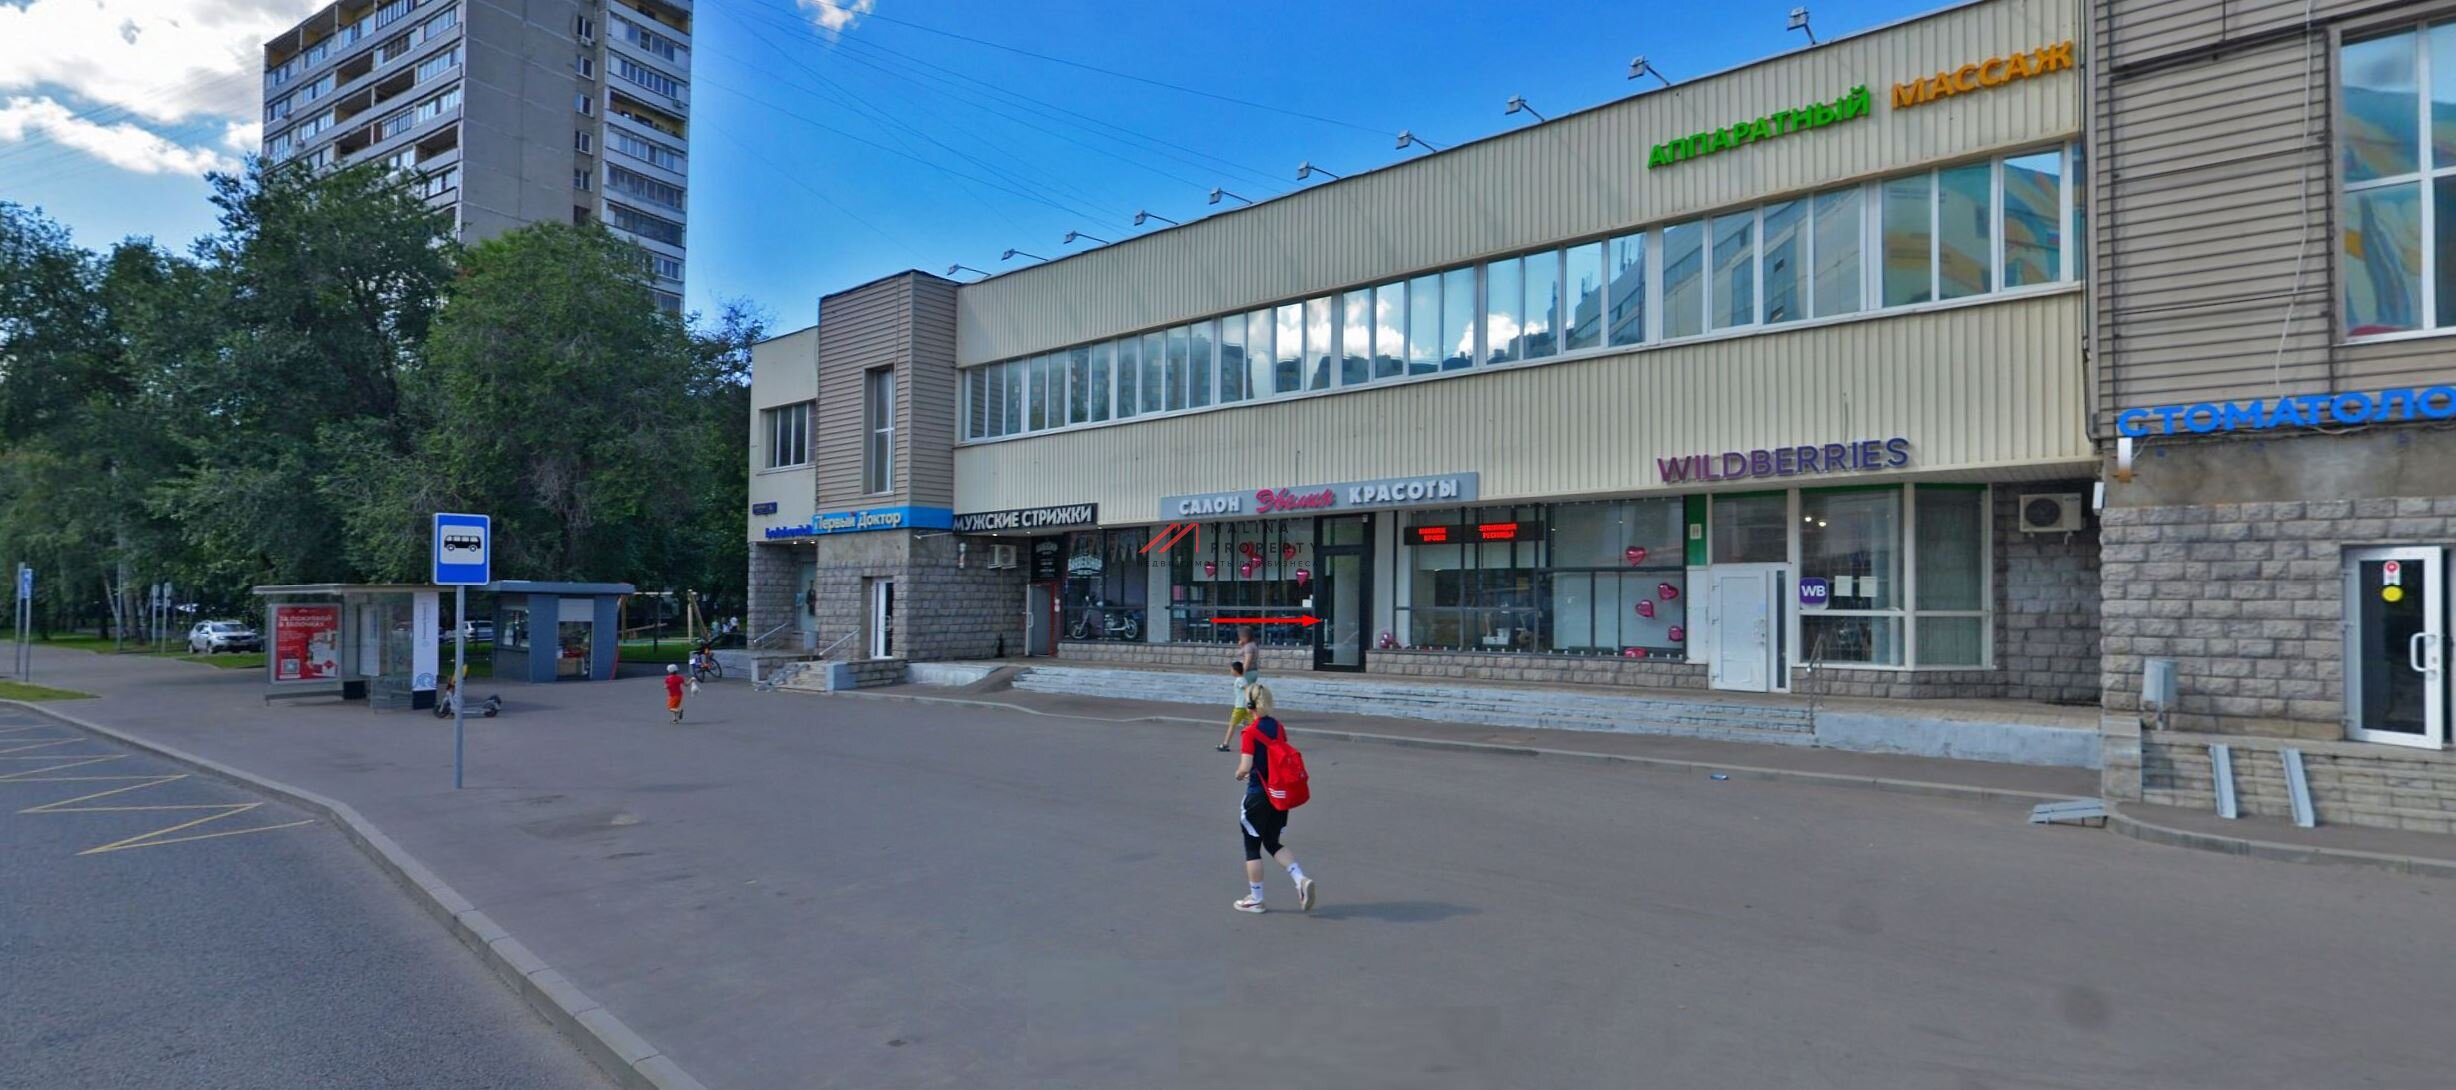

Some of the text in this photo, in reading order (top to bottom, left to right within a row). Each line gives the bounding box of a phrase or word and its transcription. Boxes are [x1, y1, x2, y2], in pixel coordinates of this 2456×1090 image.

[1648, 40, 2074, 169] АППАРАТНЫЙ МАССАЖ
[2116, 383, 2456, 438] СТОМАТОЛО
[1657, 437, 1910, 483] WILDBERRIES
[1178, 495, 1241, 516] САЛОН
[1348, 478, 1458, 505] КРАСОТЫ
[857, 511, 901, 528] Доктор
[952, 504, 1092, 532] МУЖСКИЕ СТРИЖКИ
[1801, 585, 1827, 598] WB
